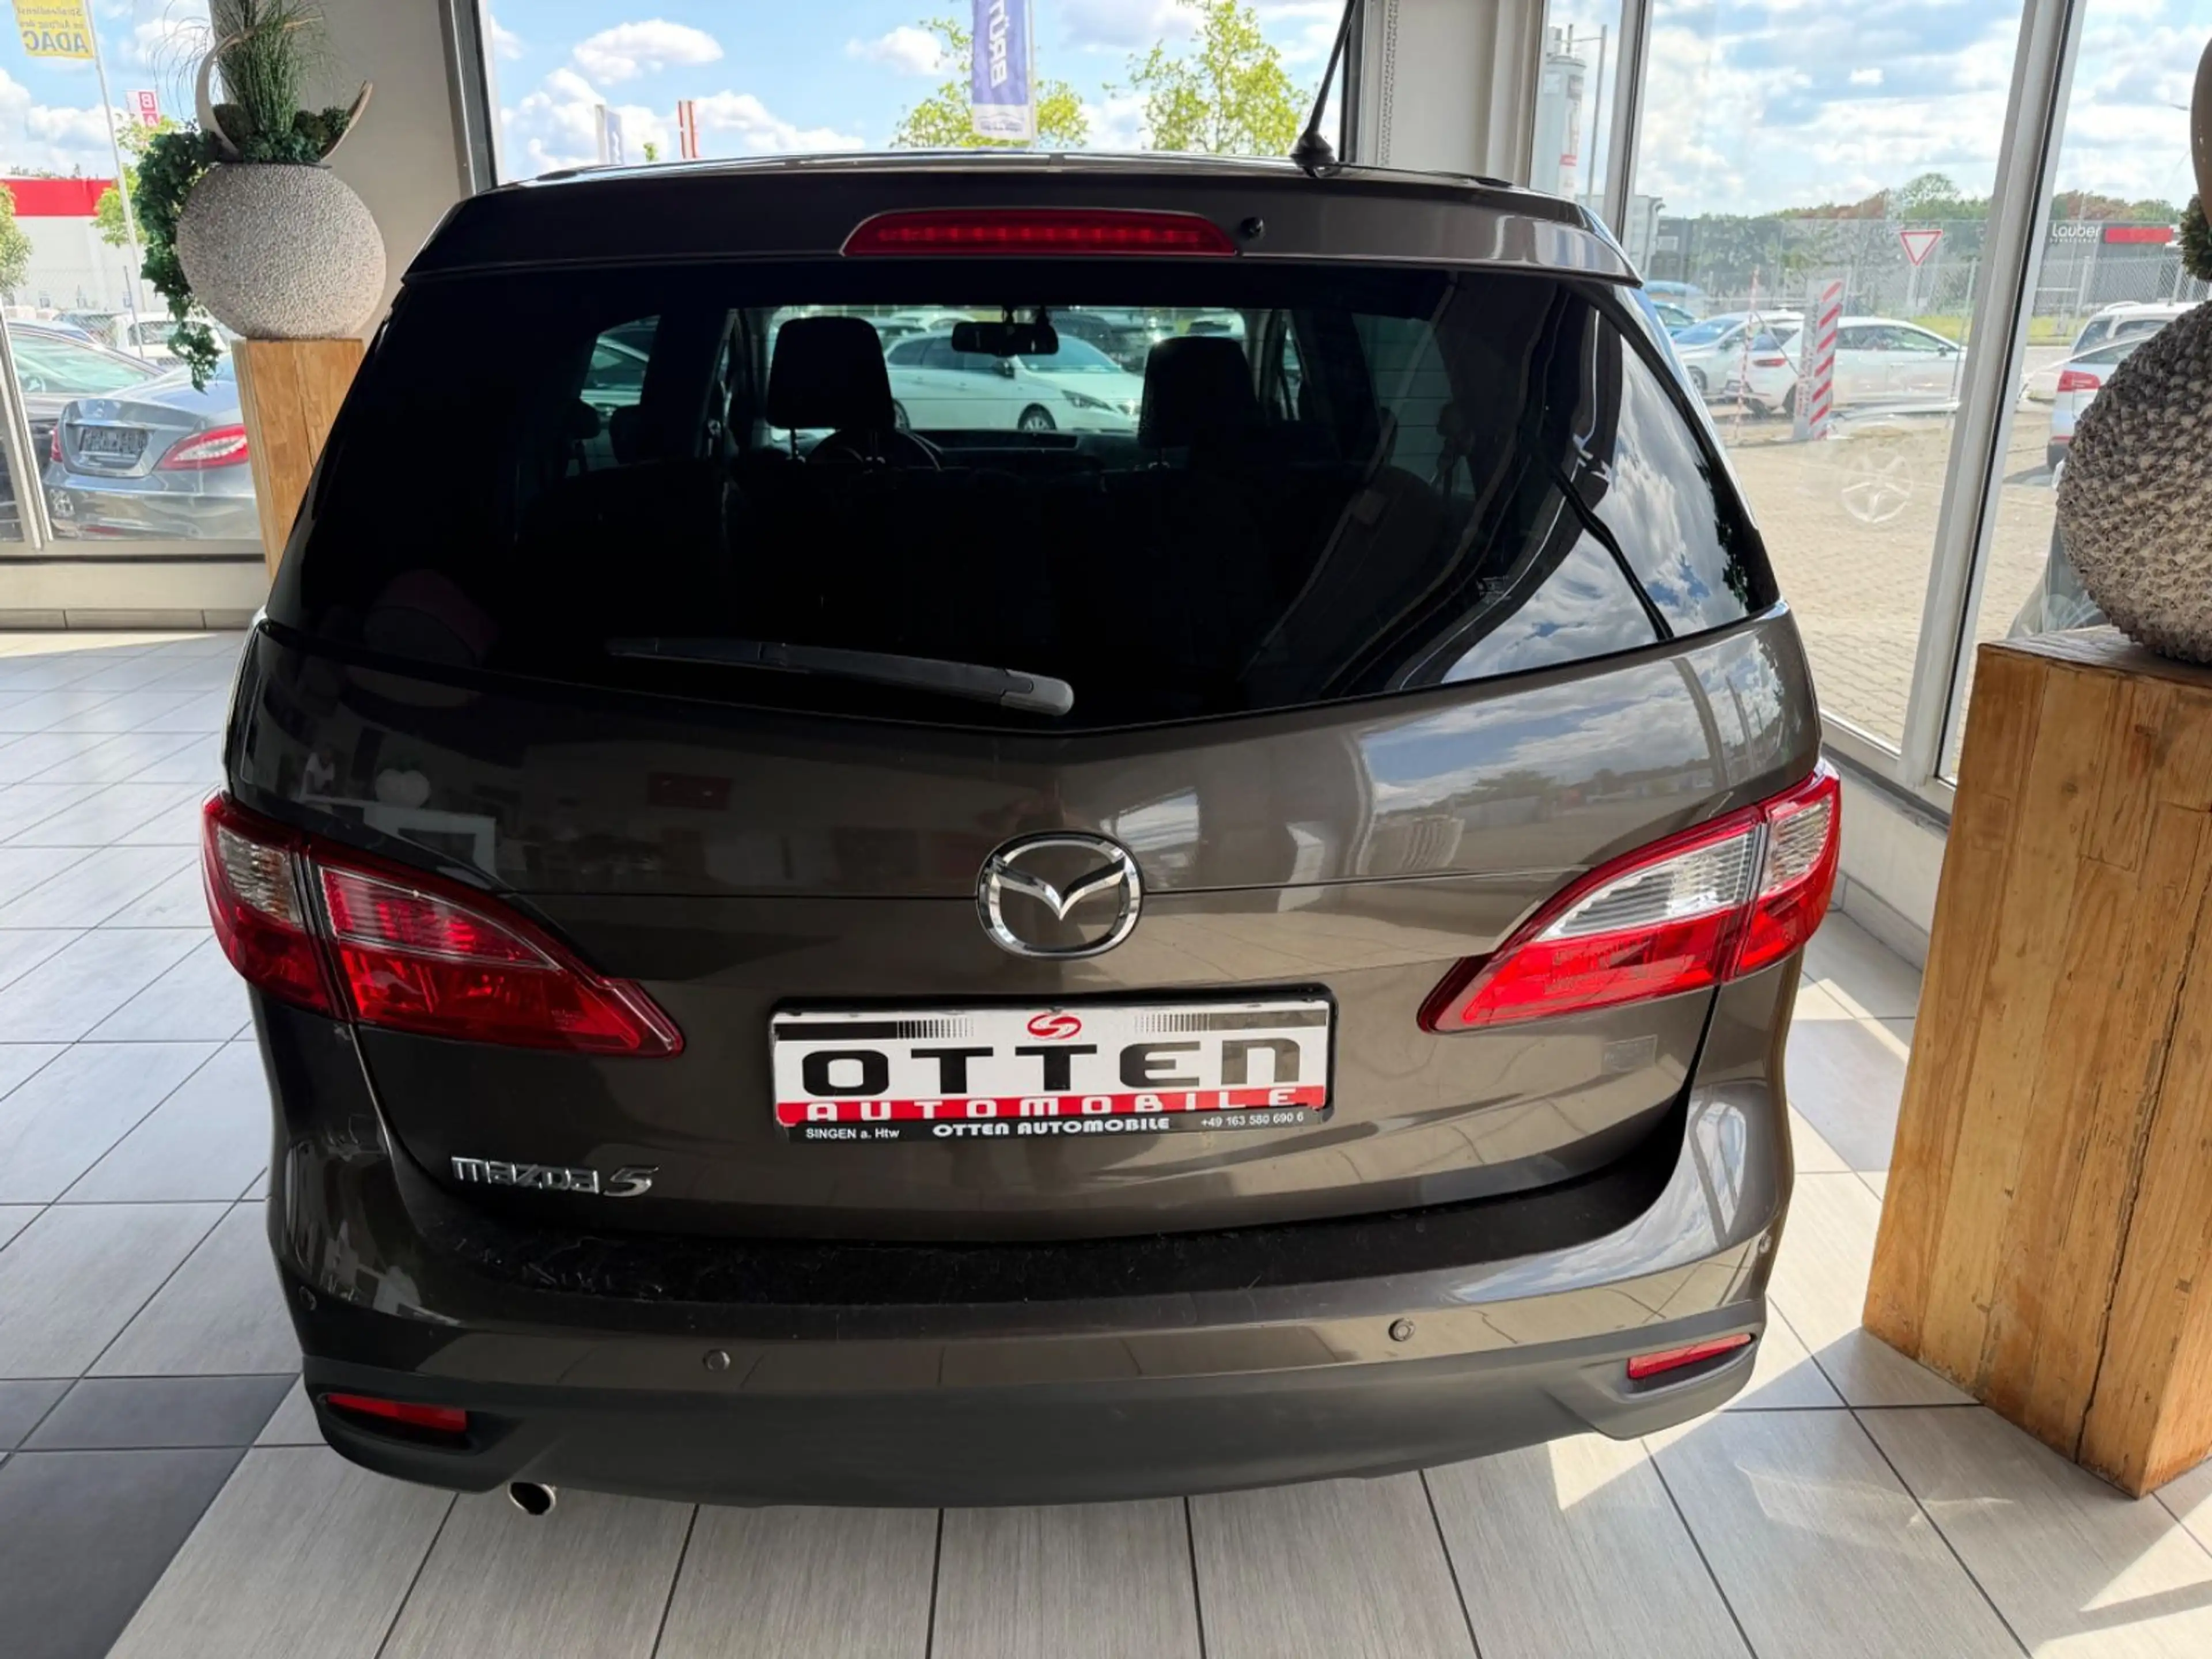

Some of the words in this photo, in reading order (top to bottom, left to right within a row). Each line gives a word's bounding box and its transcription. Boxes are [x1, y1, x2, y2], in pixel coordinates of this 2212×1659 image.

[2052, 221, 2101, 237] Lauber
[802, 1038, 1301, 1097] OTTEN
[807, 1088, 1296, 1122] AUTOMOBILE
[933, 1123, 1009, 1137] OTTEN
[1017, 1118, 1169, 1135] AUTOMOBILE
[1200, 1116, 1222, 1127] +49
[1272, 1112, 1294, 1124] 690
[1297, 1111, 1304, 1122] 6
[805, 1127, 857, 1139] SINGEN
[860, 1130, 872, 1139] a.
[875, 1127, 900, 1139] Htw
